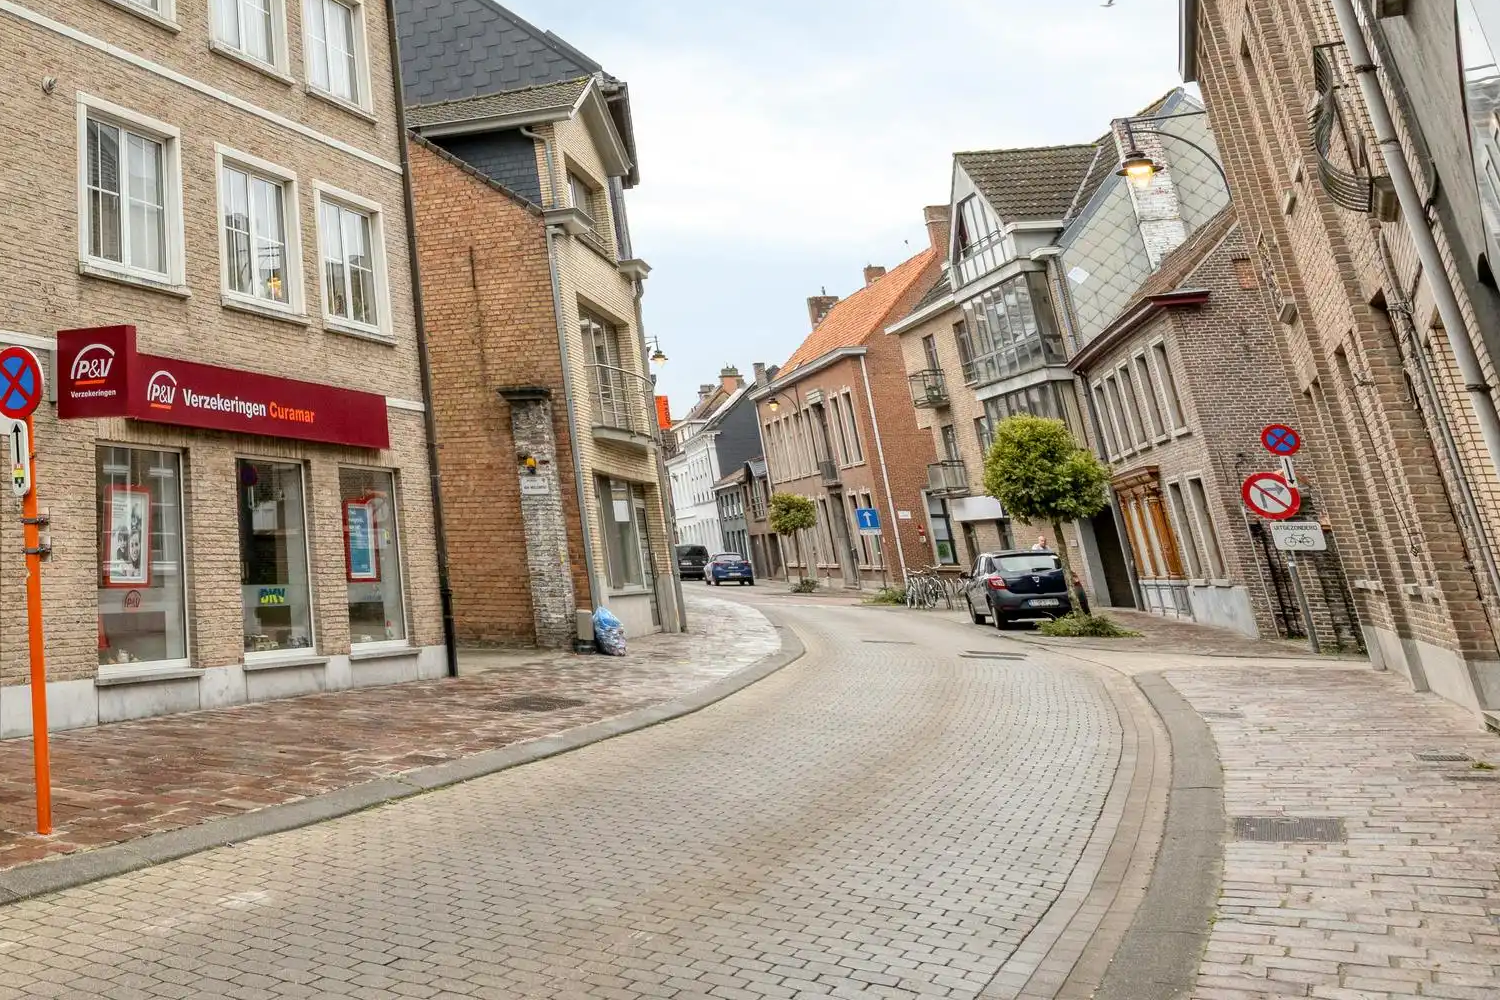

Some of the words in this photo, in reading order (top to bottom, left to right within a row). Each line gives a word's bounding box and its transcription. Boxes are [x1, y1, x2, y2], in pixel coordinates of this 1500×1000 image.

[77, 357, 113, 379] P&V
[70, 389, 116, 398] Verzekeringen
[151, 383, 176, 404] P&V
[183, 388, 266, 418] Verzekeringen
[269, 401, 315, 423] Curamar
